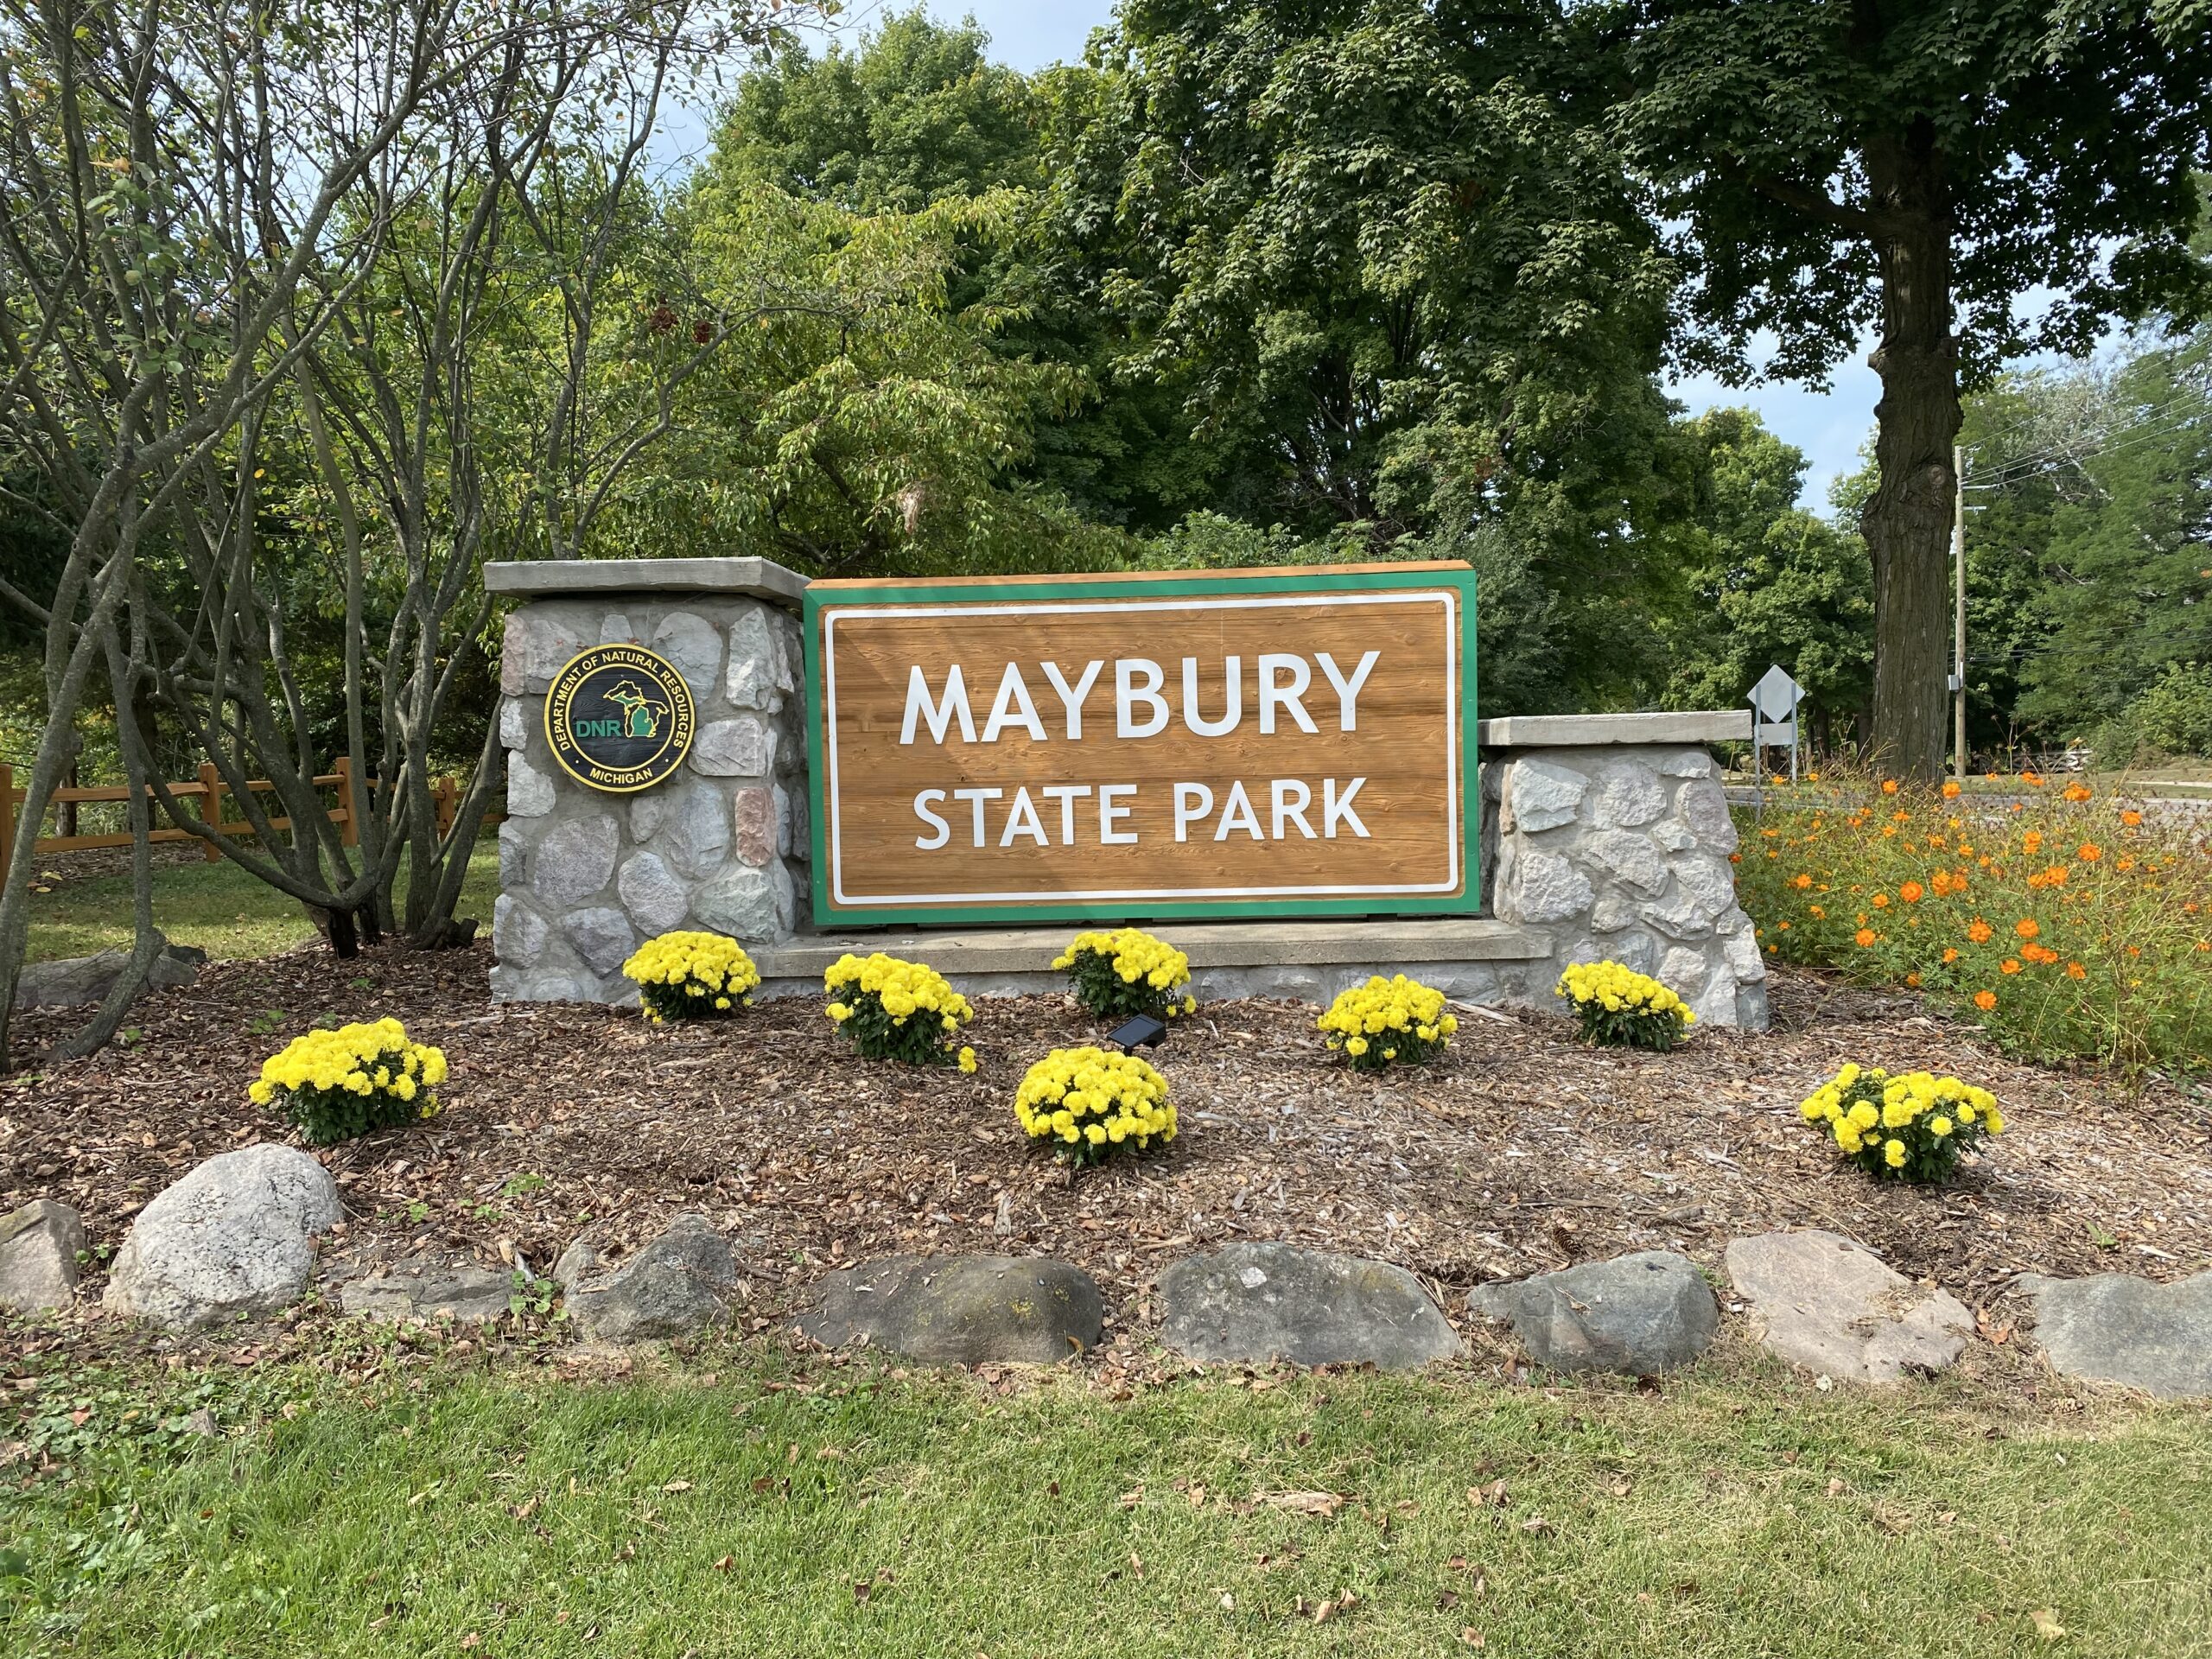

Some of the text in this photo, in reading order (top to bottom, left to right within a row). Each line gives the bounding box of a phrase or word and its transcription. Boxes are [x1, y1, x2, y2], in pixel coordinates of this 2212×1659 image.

[553, 651, 689, 751] DEPARTMENT OF NATURAL RESOURCES
[575, 720, 622, 738] DNR
[899, 651, 1382, 745] MAYBURY
[589, 767, 653, 784] MICHIGAN
[913, 778, 1372, 850] STATE PARK
